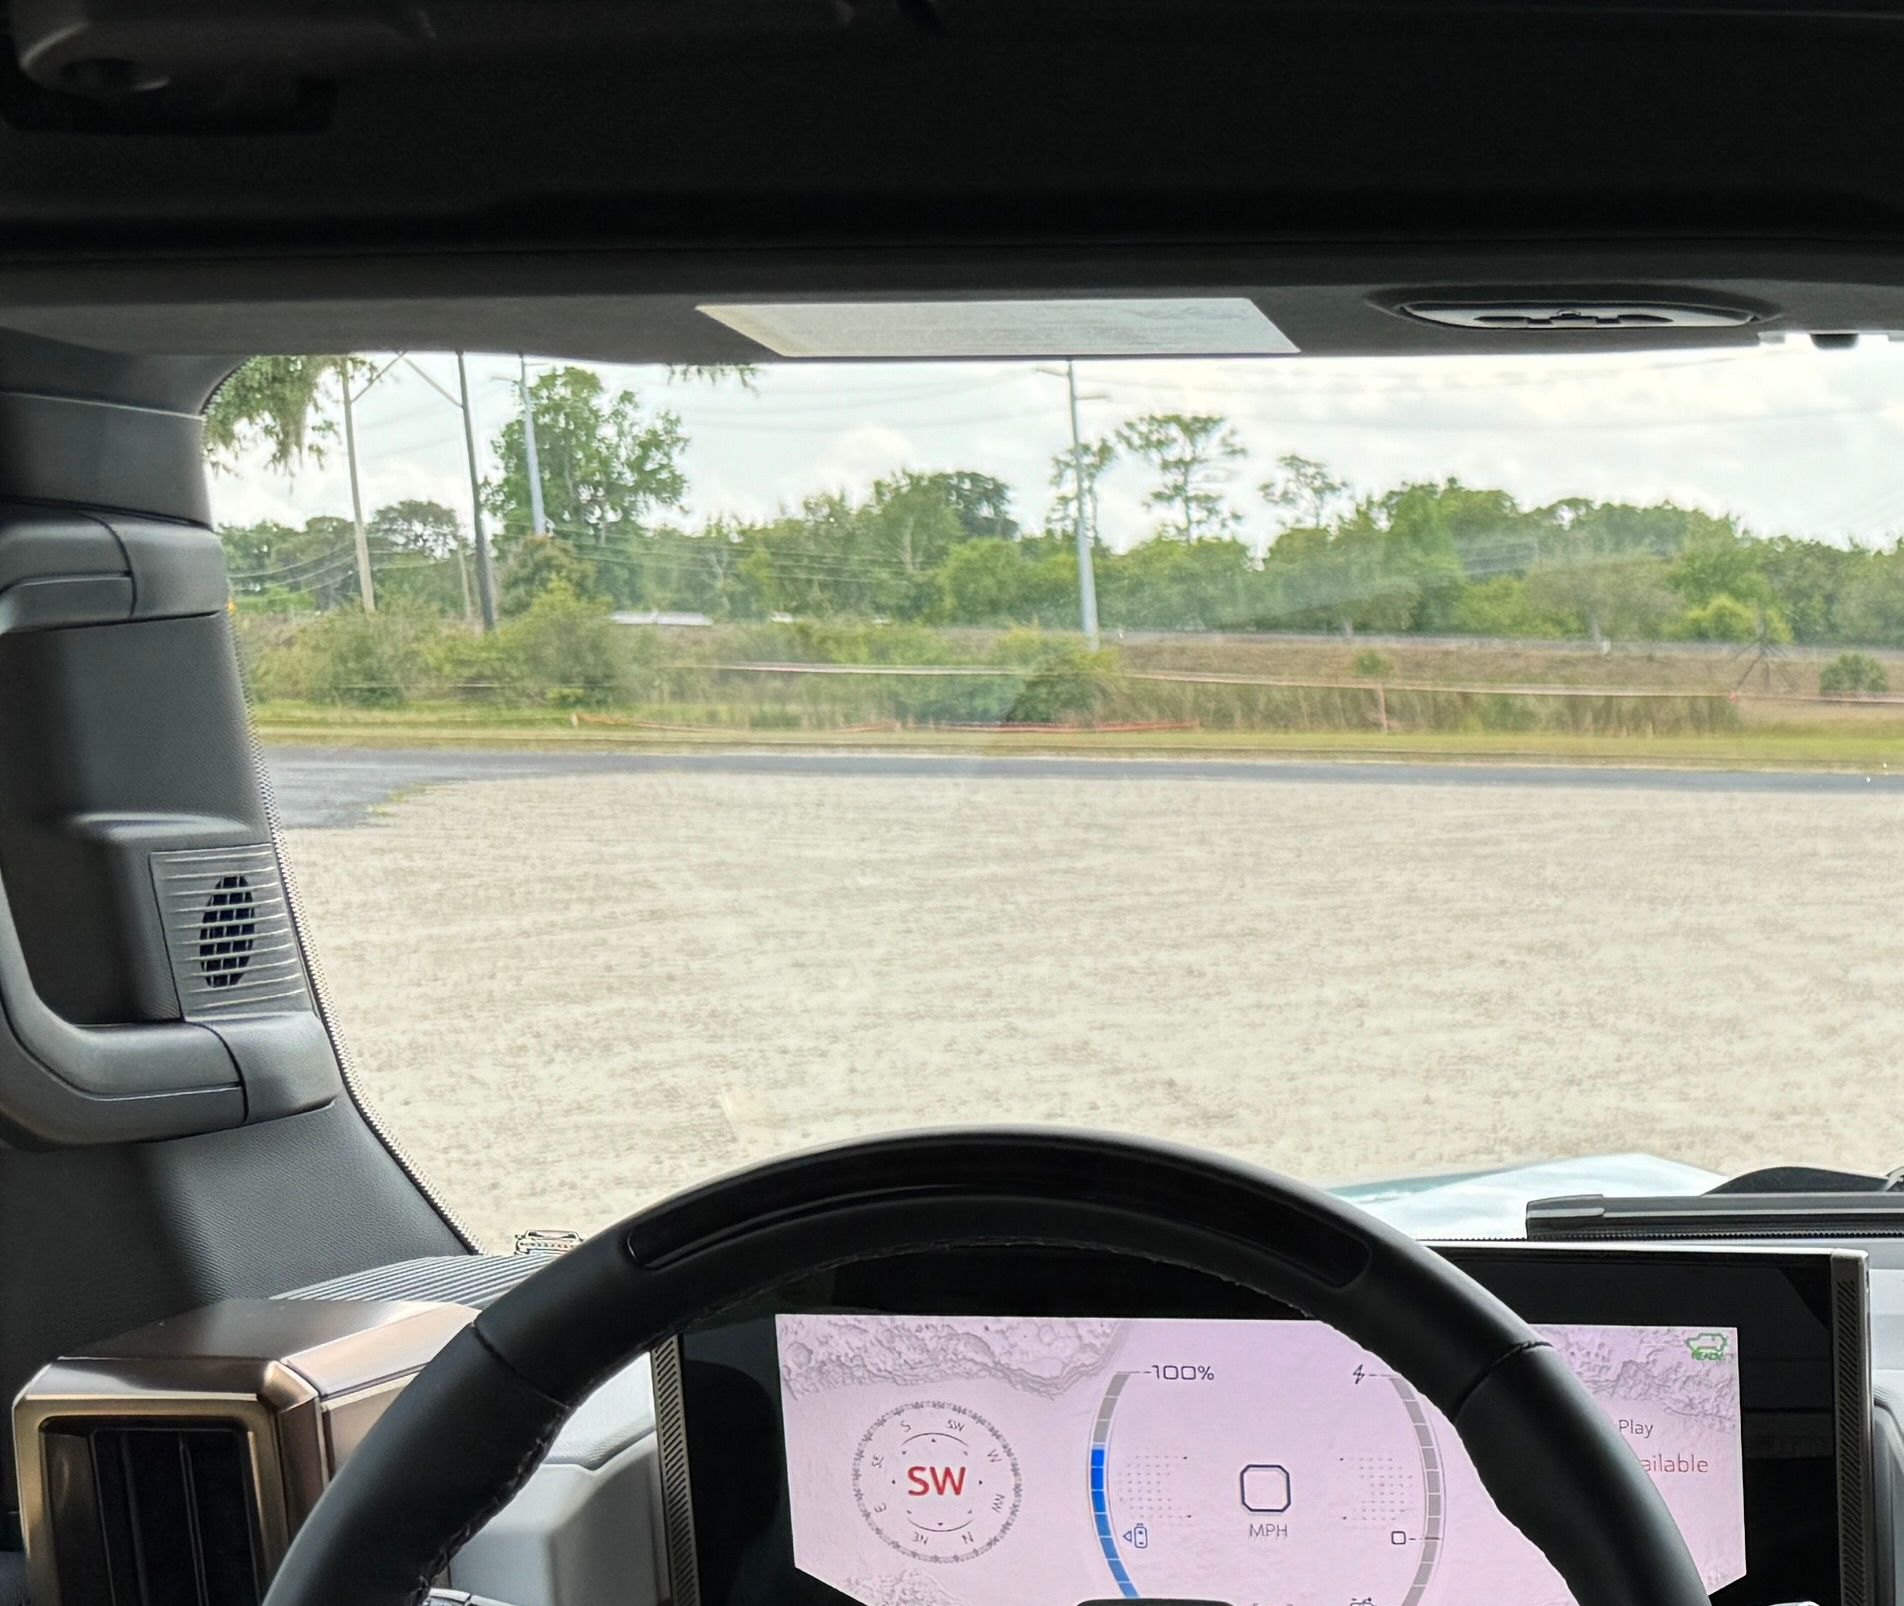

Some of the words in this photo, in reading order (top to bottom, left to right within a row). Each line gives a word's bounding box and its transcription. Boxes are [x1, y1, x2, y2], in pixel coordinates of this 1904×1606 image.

[1149, 1364, 1215, 1382] 100%
[946, 1419, 965, 1432] SW
[1618, 1419, 1654, 1439] Play
[1640, 1453, 1709, 1473] ailable
[907, 1465, 966, 1496] SW
[1248, 1523, 1289, 1539] MPH
